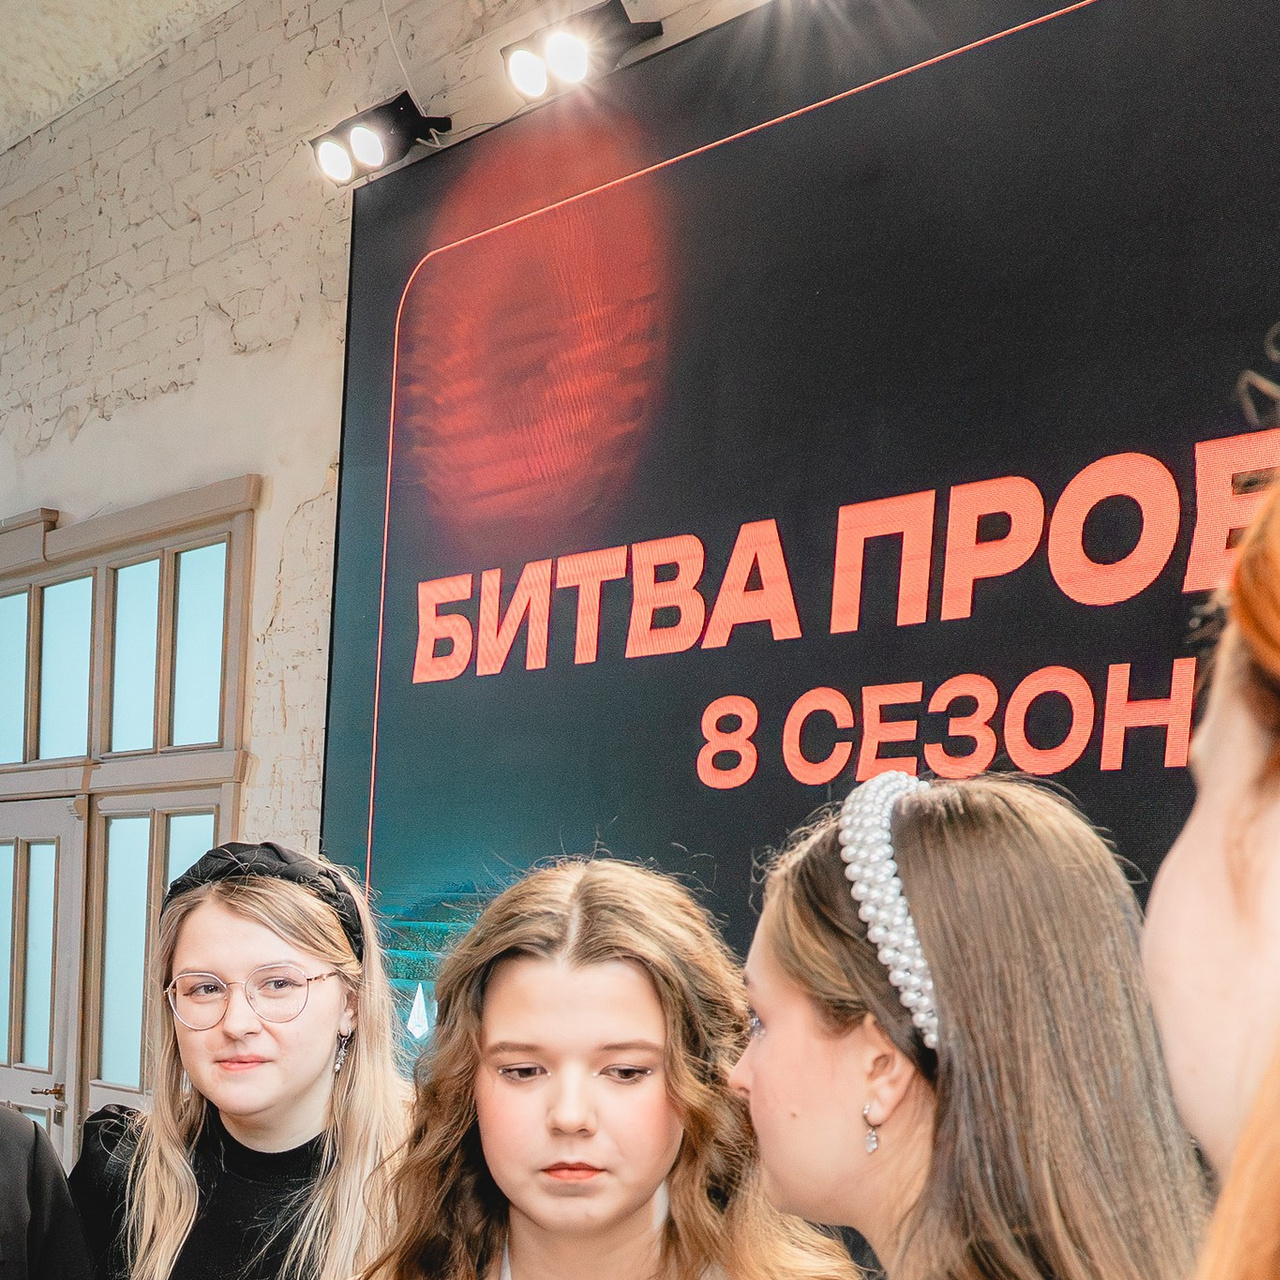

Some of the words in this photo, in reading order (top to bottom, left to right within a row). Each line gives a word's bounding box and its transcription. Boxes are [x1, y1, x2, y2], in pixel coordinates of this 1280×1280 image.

[411, 519, 801, 684] БИТВА
[830, 427, 1280, 634] ПРОЕ
[696, 695, 758, 790] 8
[782, 657, 1197, 785] СЕЗОН
